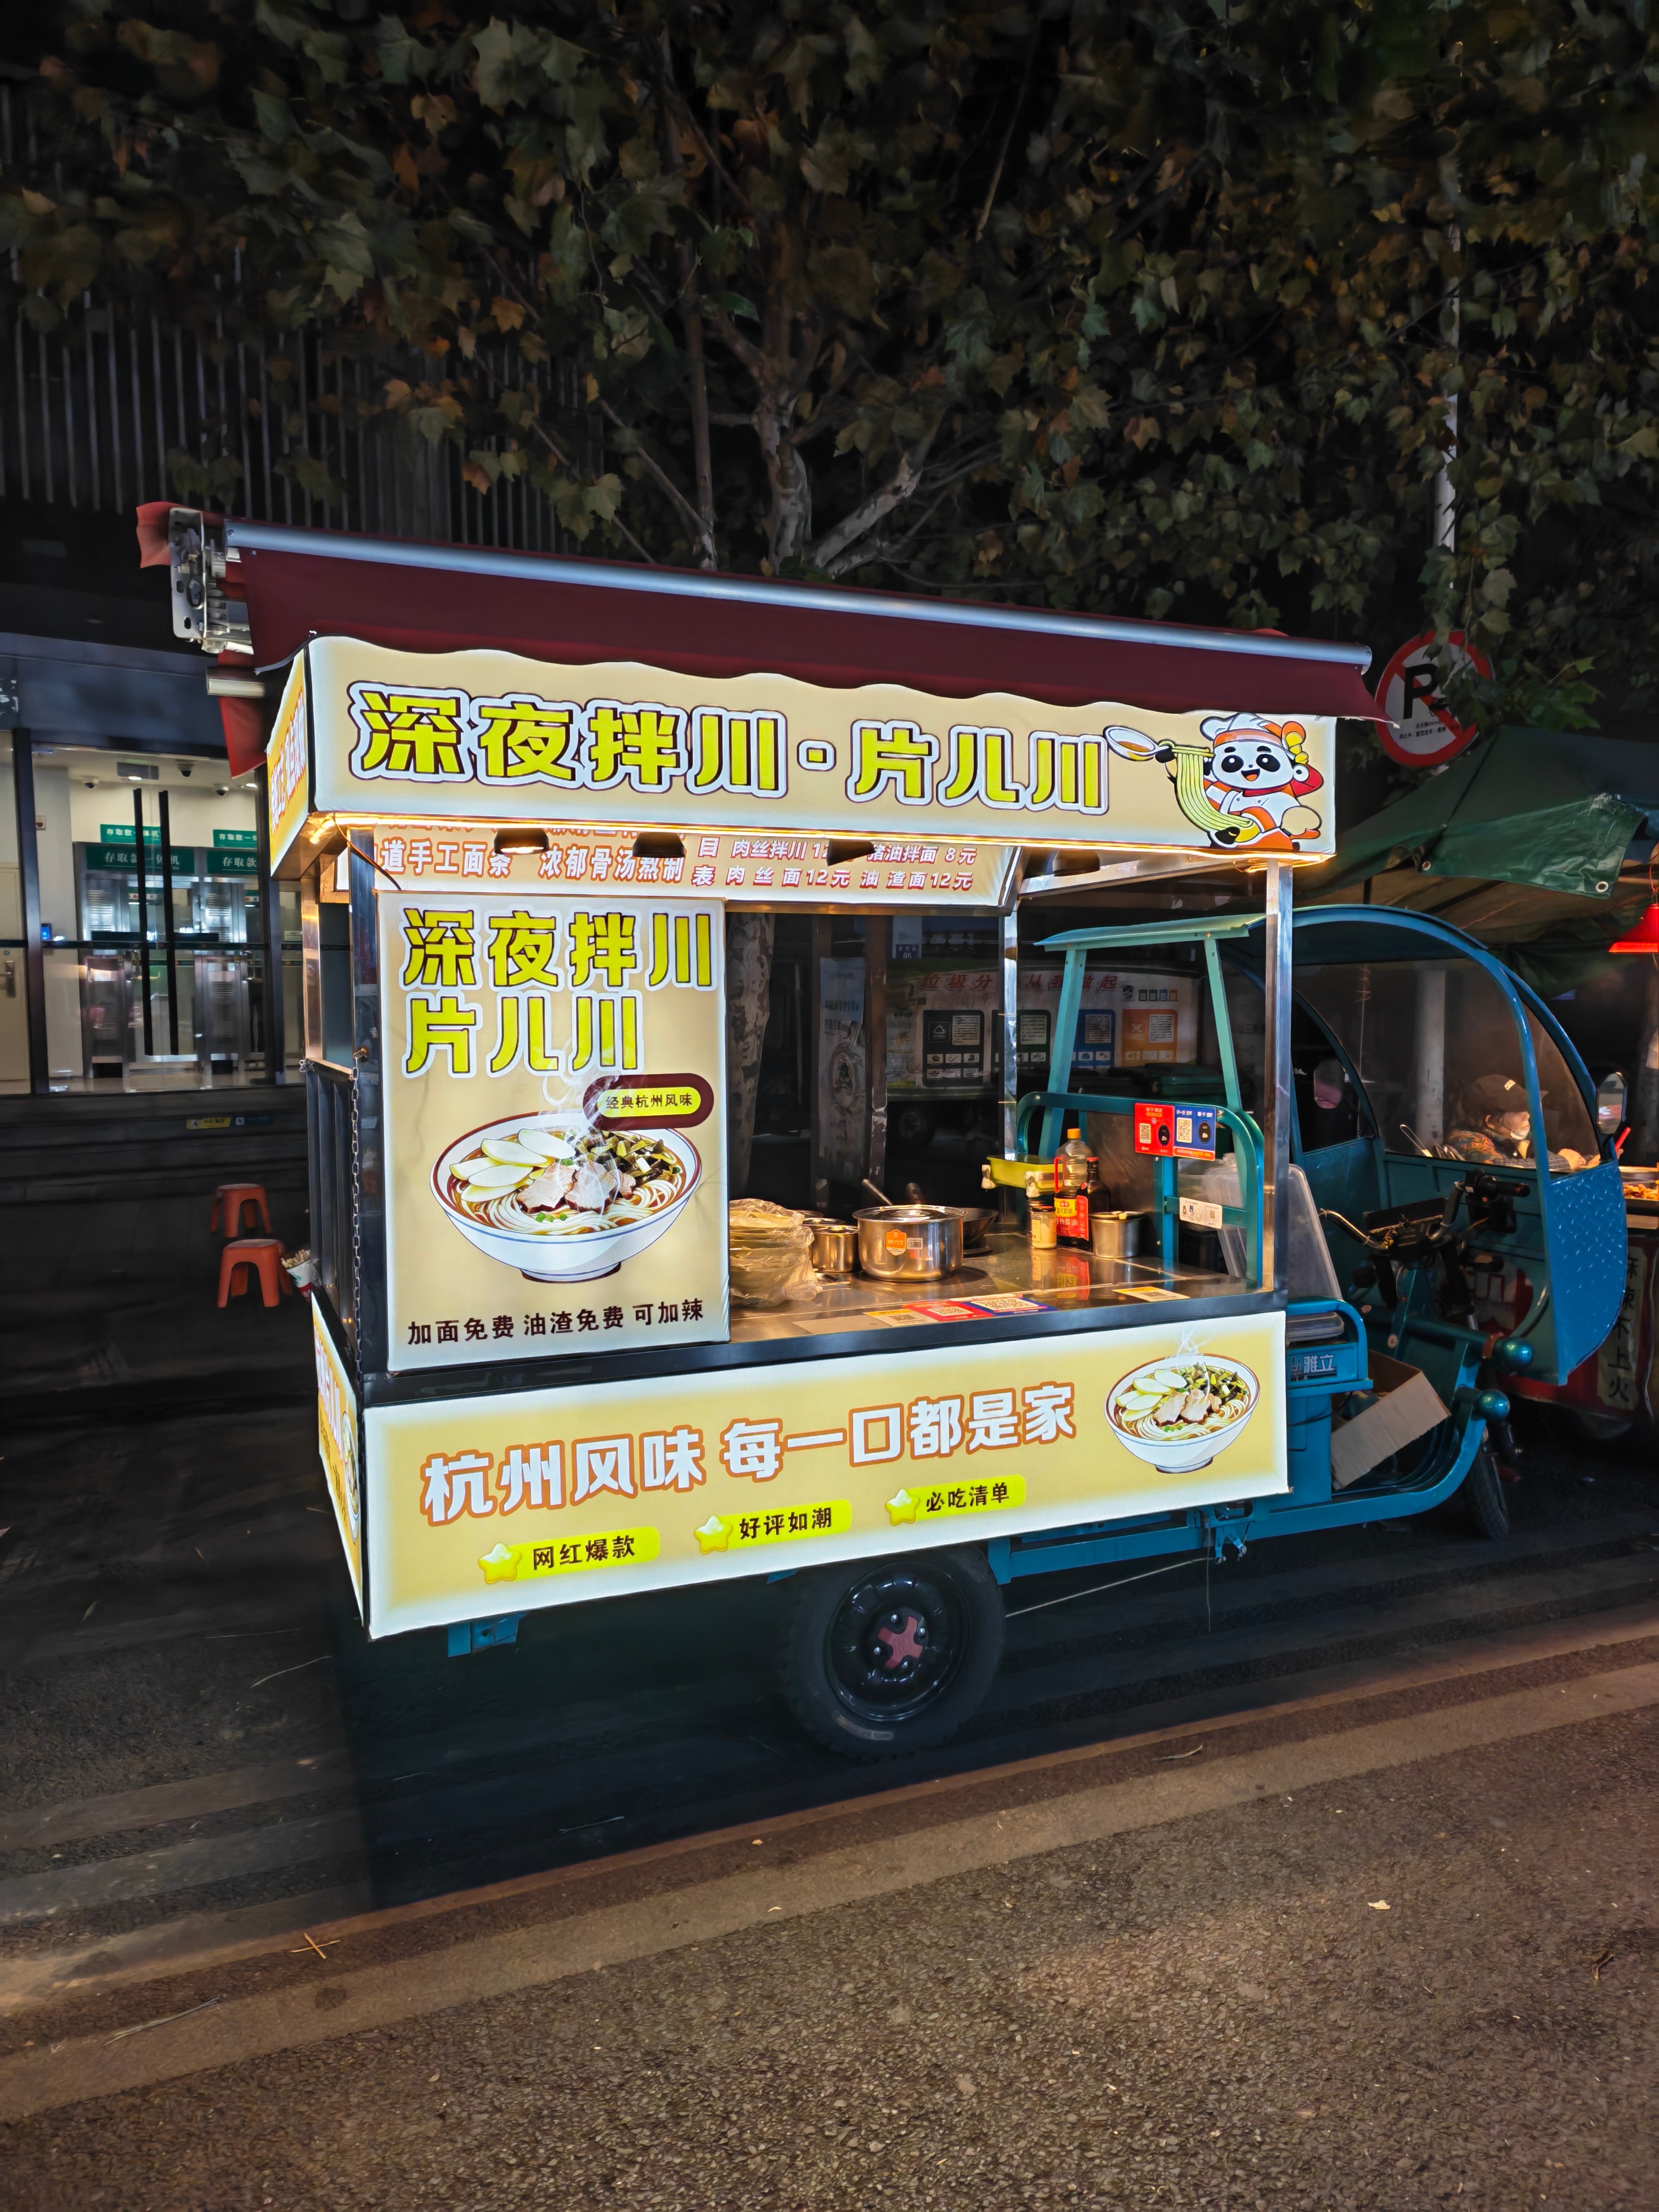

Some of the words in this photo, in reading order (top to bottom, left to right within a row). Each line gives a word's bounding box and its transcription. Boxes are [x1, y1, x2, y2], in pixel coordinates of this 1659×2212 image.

[106, 828, 160, 838] 存取款体机
[222, 857, 257, 868] 存取款
[374, 839, 512, 879] 道手工面条
[540, 844, 685, 882] 浓郁骨汤熬制
[731, 839, 806, 861] 肉丝拌川
[944, 846, 977, 865] 8元
[725, 866, 801, 887] 肉丝面
[806, 868, 851, 888] 12元
[859, 869, 928, 890] 油渣面
[931, 872, 974, 892] 12元
[402, 907, 713, 988] 深夜拌川
[405, 995, 639, 1074] 片儿川
[605, 1093, 693, 1110] 经典杭州风味
[407, 1314, 515, 1346] 加面免费
[523, 1306, 624, 1336] 油渣免费
[632, 1297, 704, 1327] 可加辣
[1303, 1353, 1335, 1374] 雅立
[419, 1424, 707, 1526] 杭州风味
[720, 1381, 1076, 1482] 每一口都是家
[924, 1482, 1010, 1514] 必吃清单
[738, 1505, 833, 1541] 好评如潮
[532, 1535, 636, 1571] 网红爆款
